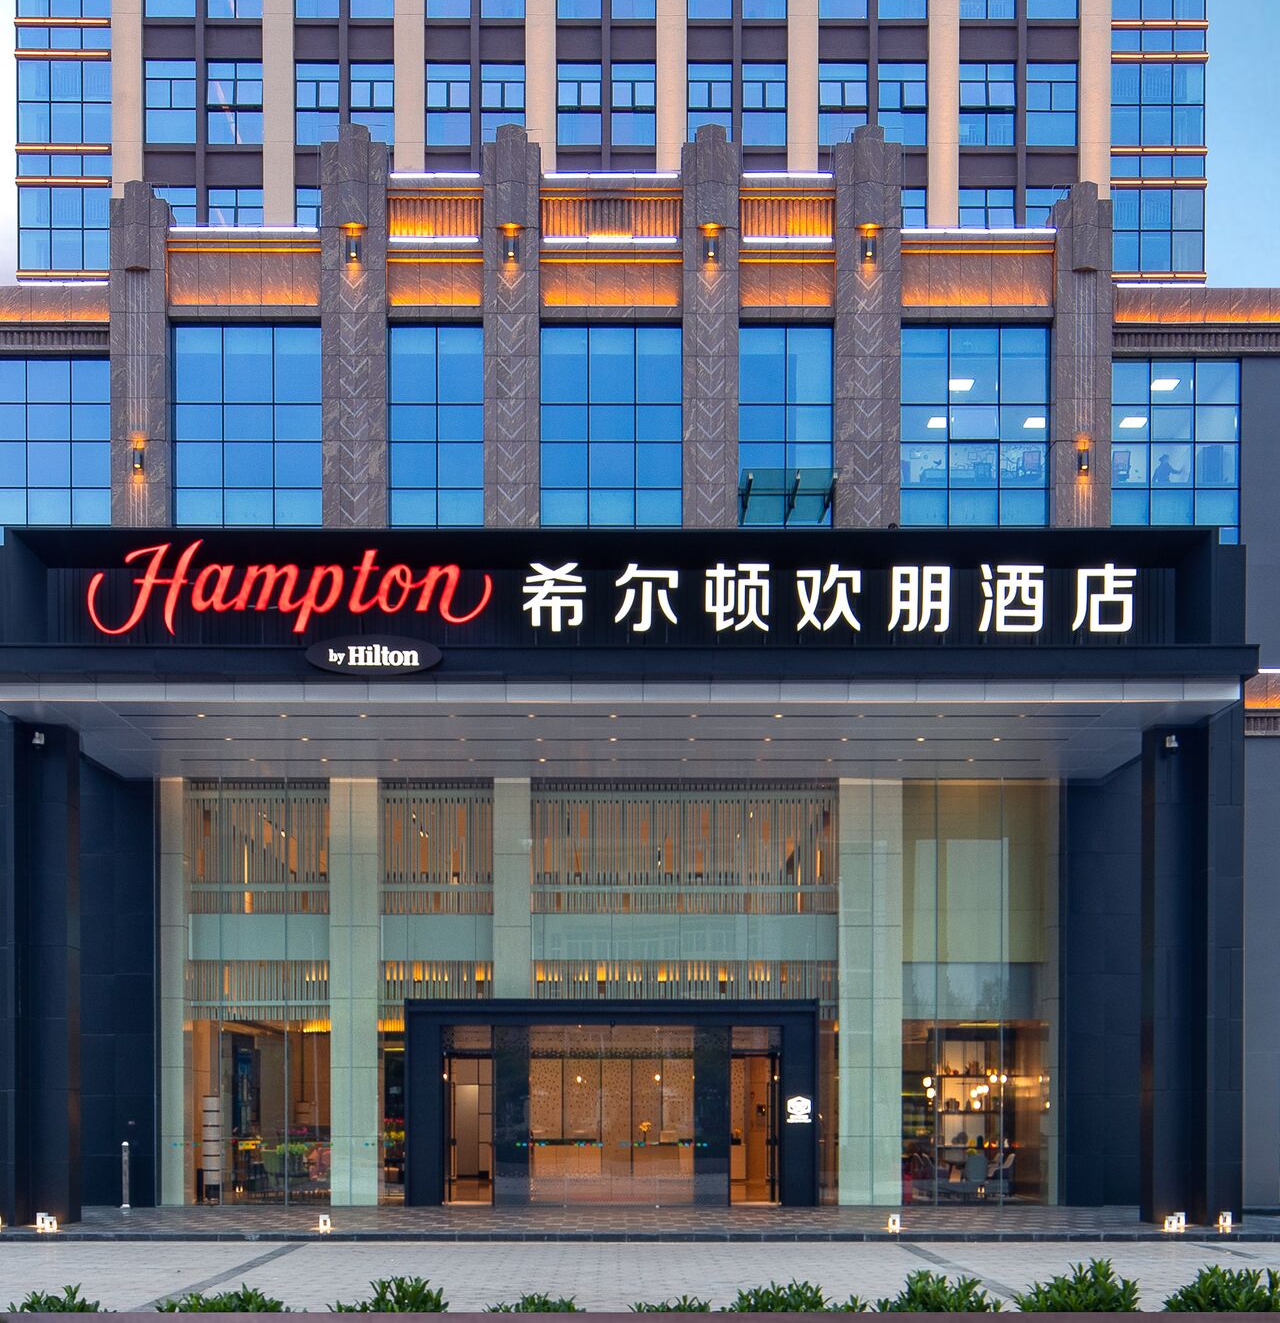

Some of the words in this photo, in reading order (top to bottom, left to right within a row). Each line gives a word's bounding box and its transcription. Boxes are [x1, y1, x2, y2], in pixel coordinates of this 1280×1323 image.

[86, 538, 493, 636] Hampton
[522, 562, 1137, 633] 希尔顿欢朋酒店
[328, 648, 346, 666] by
[347, 643, 420, 667] Hilton
